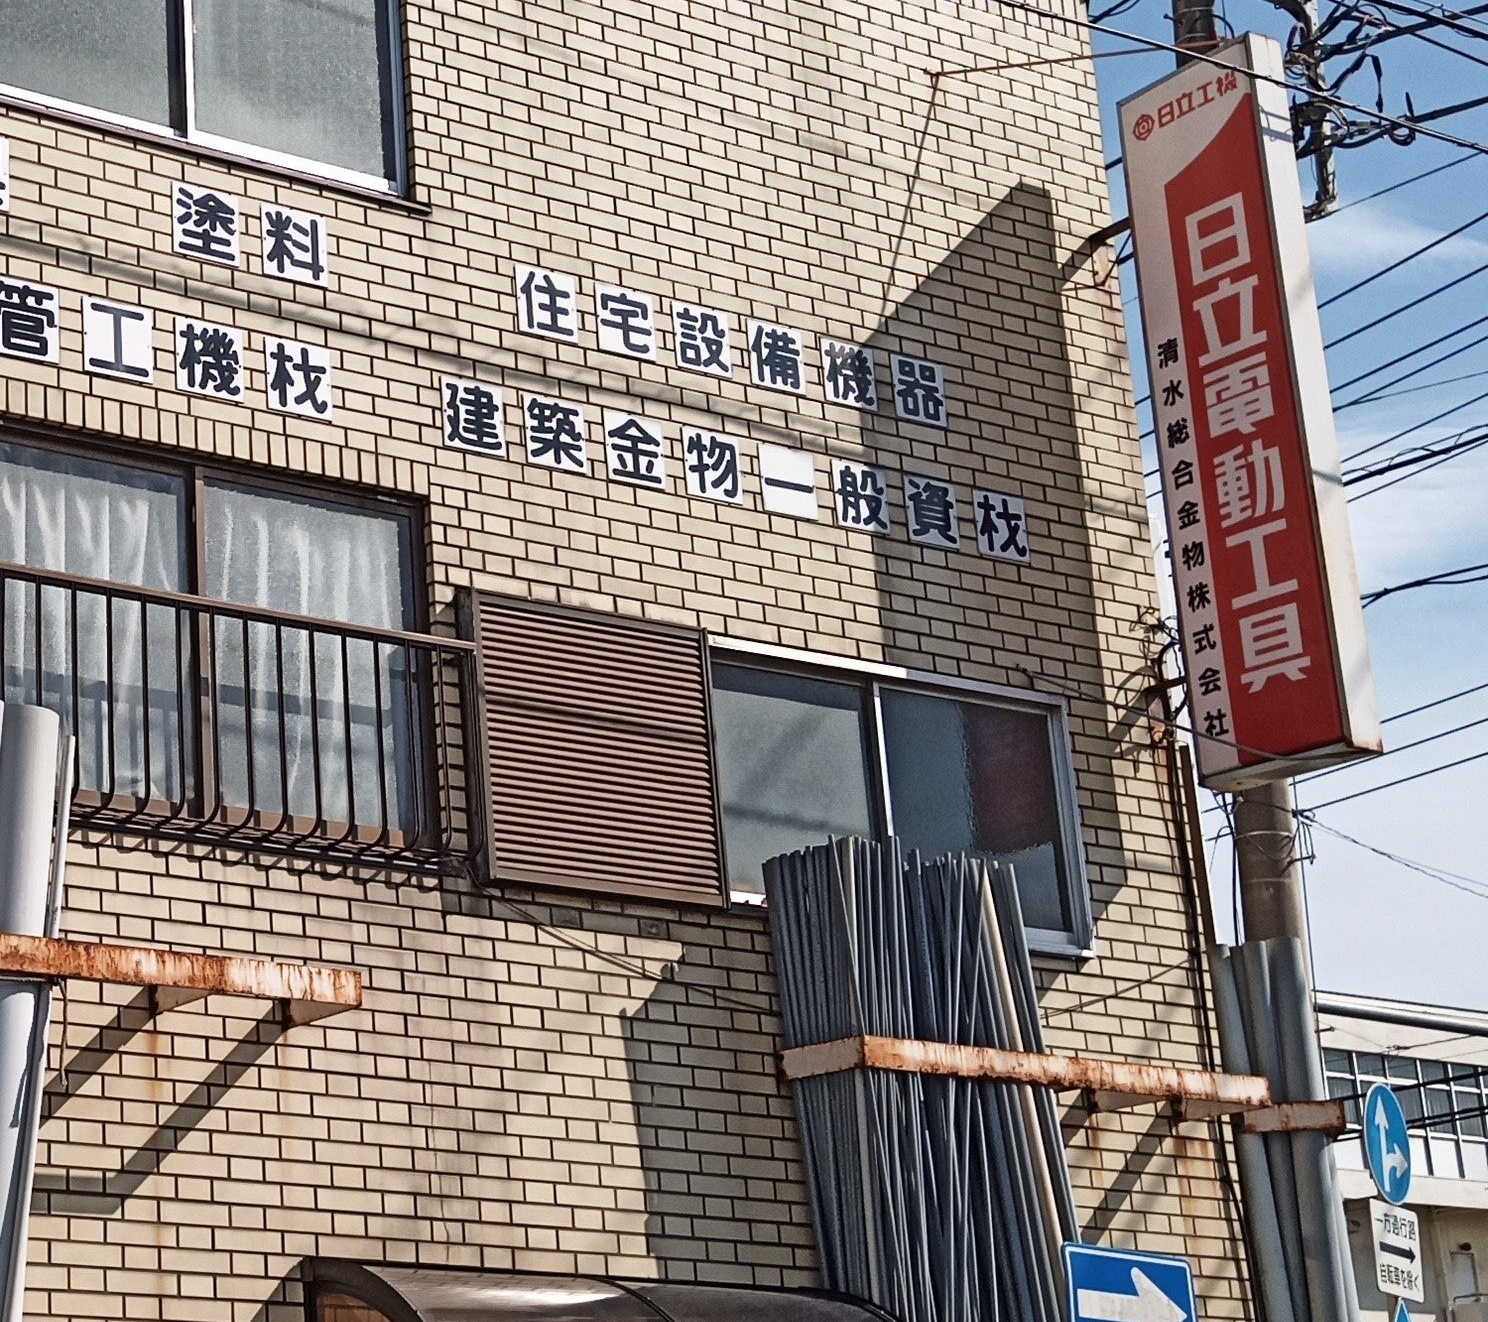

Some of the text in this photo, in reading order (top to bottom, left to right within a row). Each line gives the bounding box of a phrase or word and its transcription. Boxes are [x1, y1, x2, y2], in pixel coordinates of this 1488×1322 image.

[1157, 71, 1238, 129] 日立工機
[176, 188, 325, 282] 塗料
[520, 270, 944, 422] 住宅設備機器
[1185, 191, 1311, 694] 日立電動工具
[1158, 337, 1229, 738] 清水総合金物株式会社
[1375, 1212, 1417, 1241] 一方通行路
[1379, 1262, 1420, 1292] 自転車を除く
